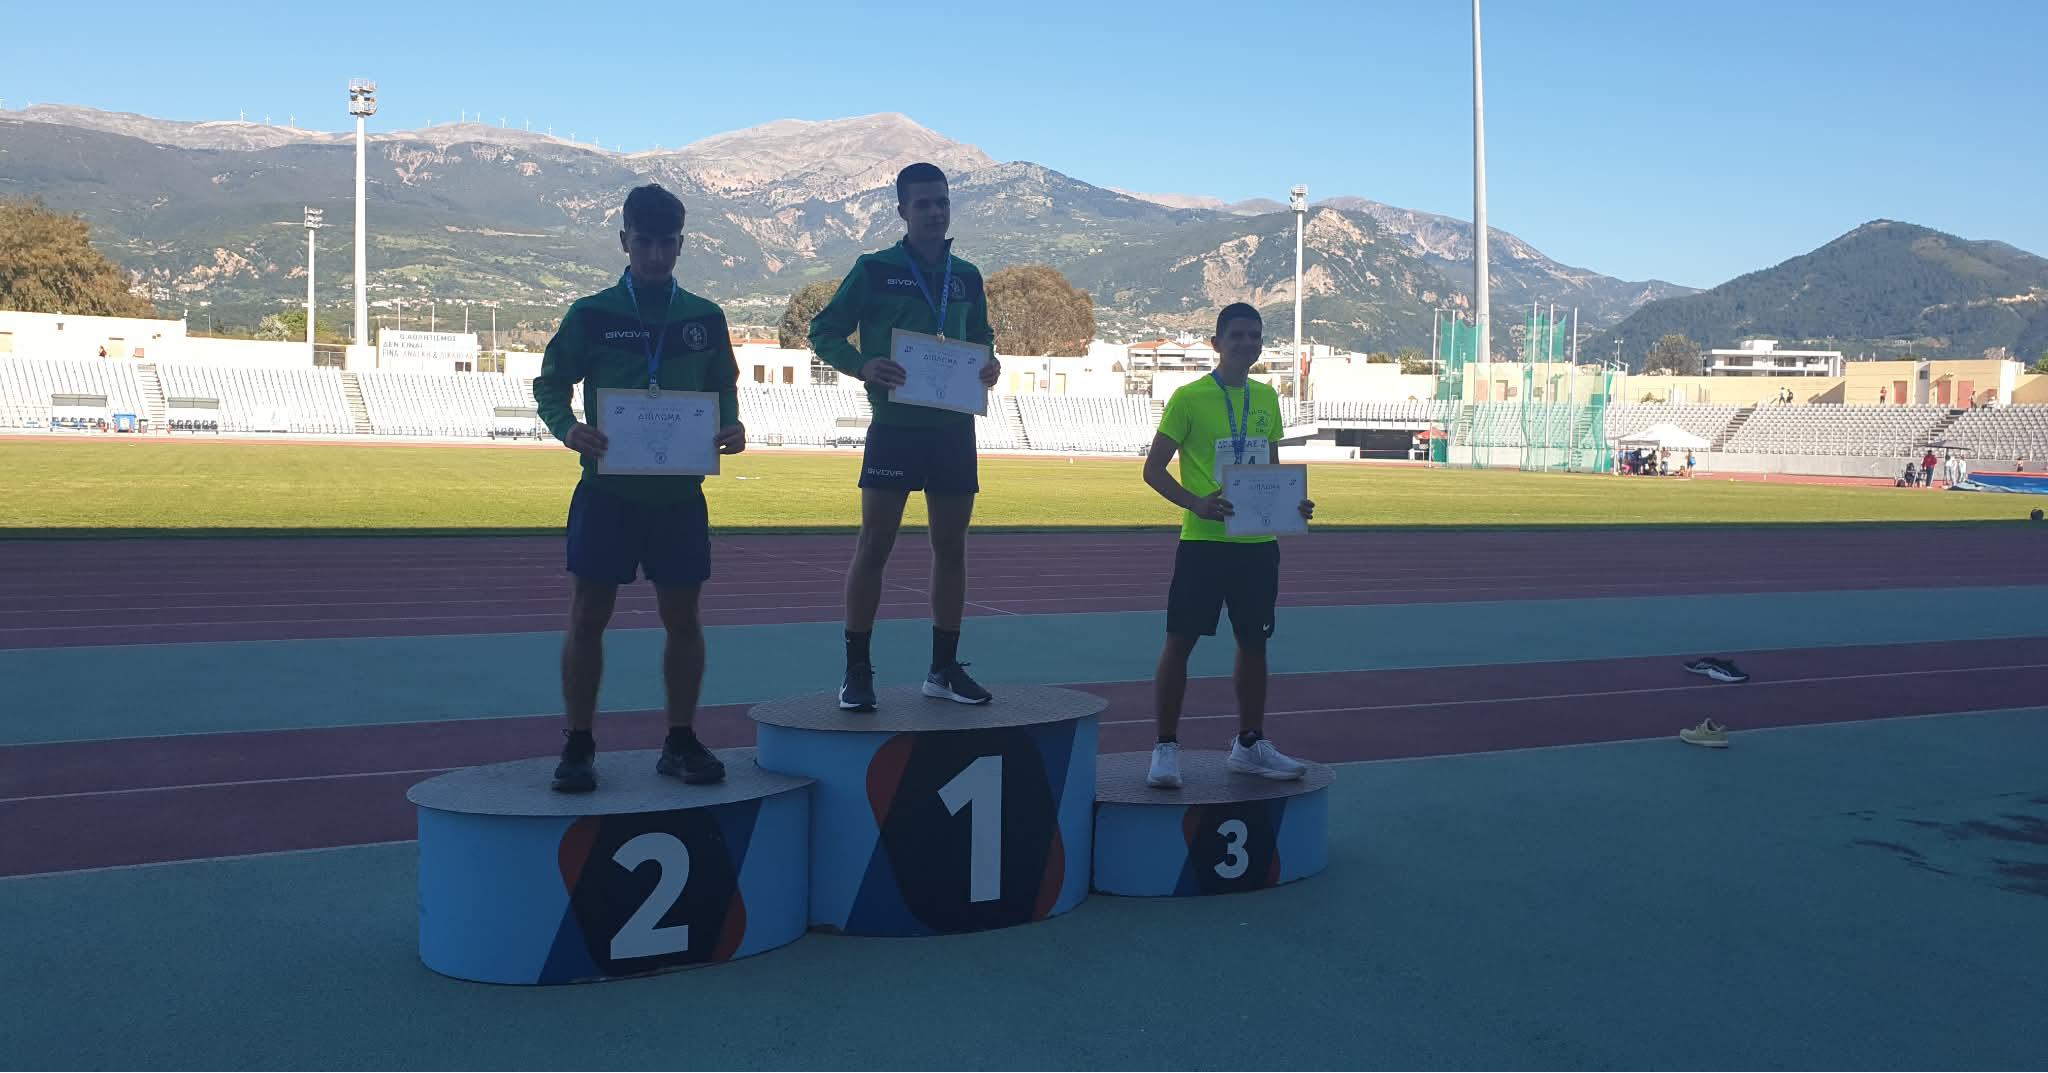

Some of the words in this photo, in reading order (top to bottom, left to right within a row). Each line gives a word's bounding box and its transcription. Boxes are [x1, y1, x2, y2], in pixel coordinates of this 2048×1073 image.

[638, 413, 681, 421] ΔΙΠΛΩΜΑ
[937, 754, 1003, 903] 1
[1214, 819, 1249, 879] 3
[610, 832, 690, 960] 2
